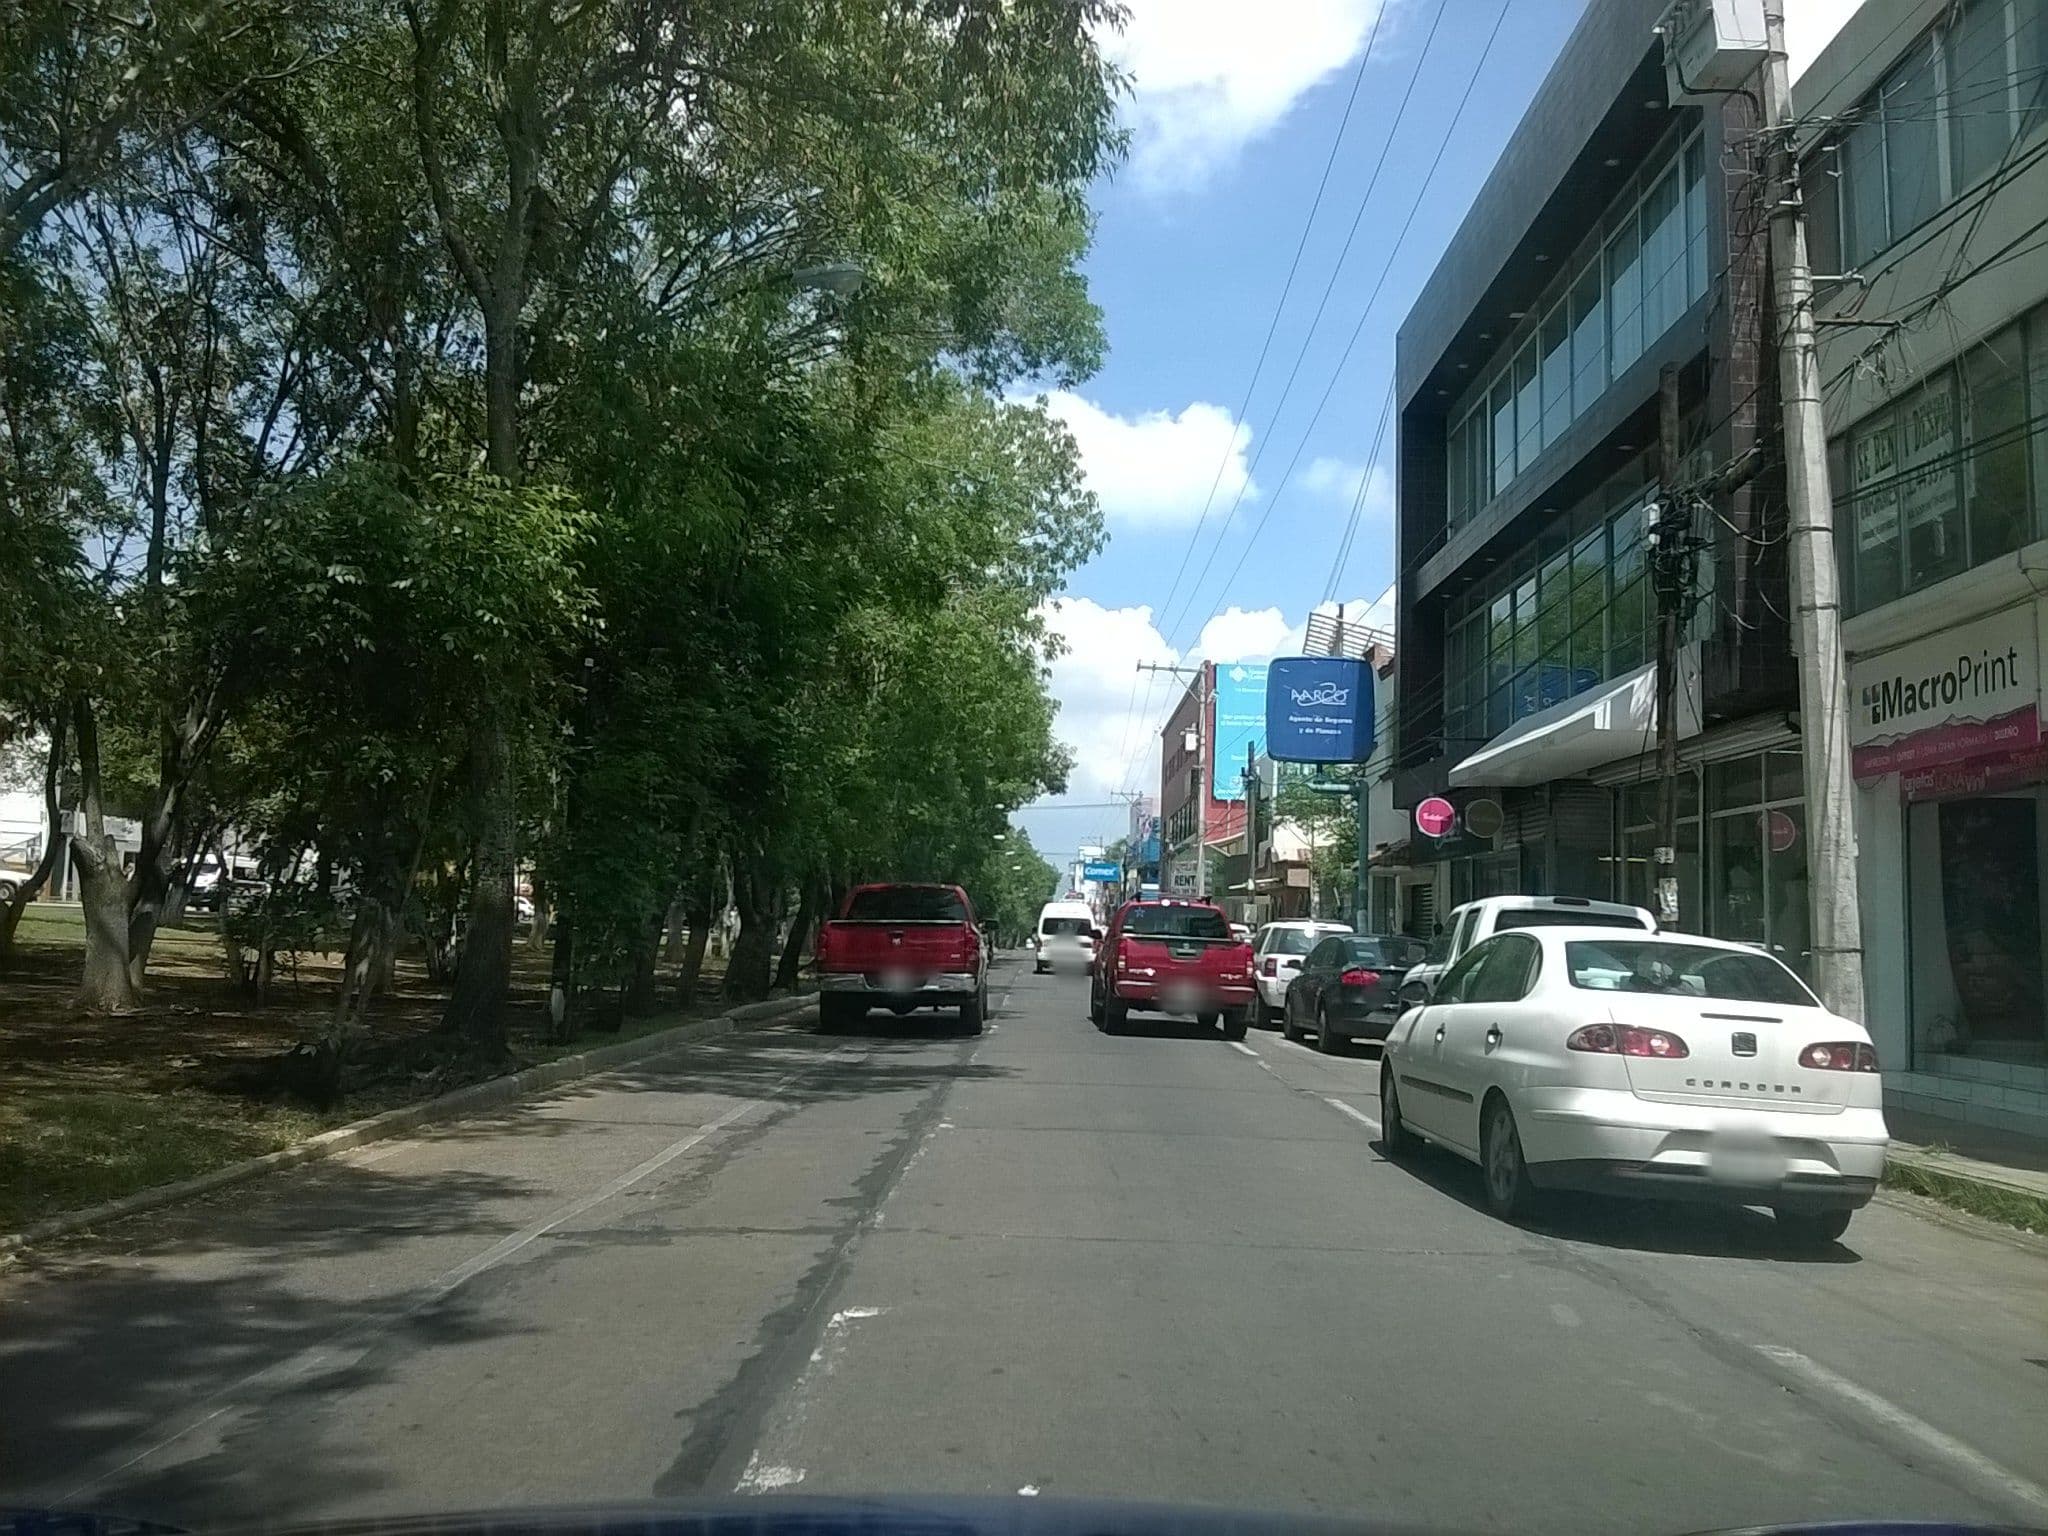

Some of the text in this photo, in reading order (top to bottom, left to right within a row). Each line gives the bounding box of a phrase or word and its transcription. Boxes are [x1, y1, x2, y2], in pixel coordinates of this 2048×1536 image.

[1881, 646, 2018, 722] MacroPrint
[1085, 867, 1116, 876] Comex
[1686, 1079, 1801, 1093] CORDOBA
